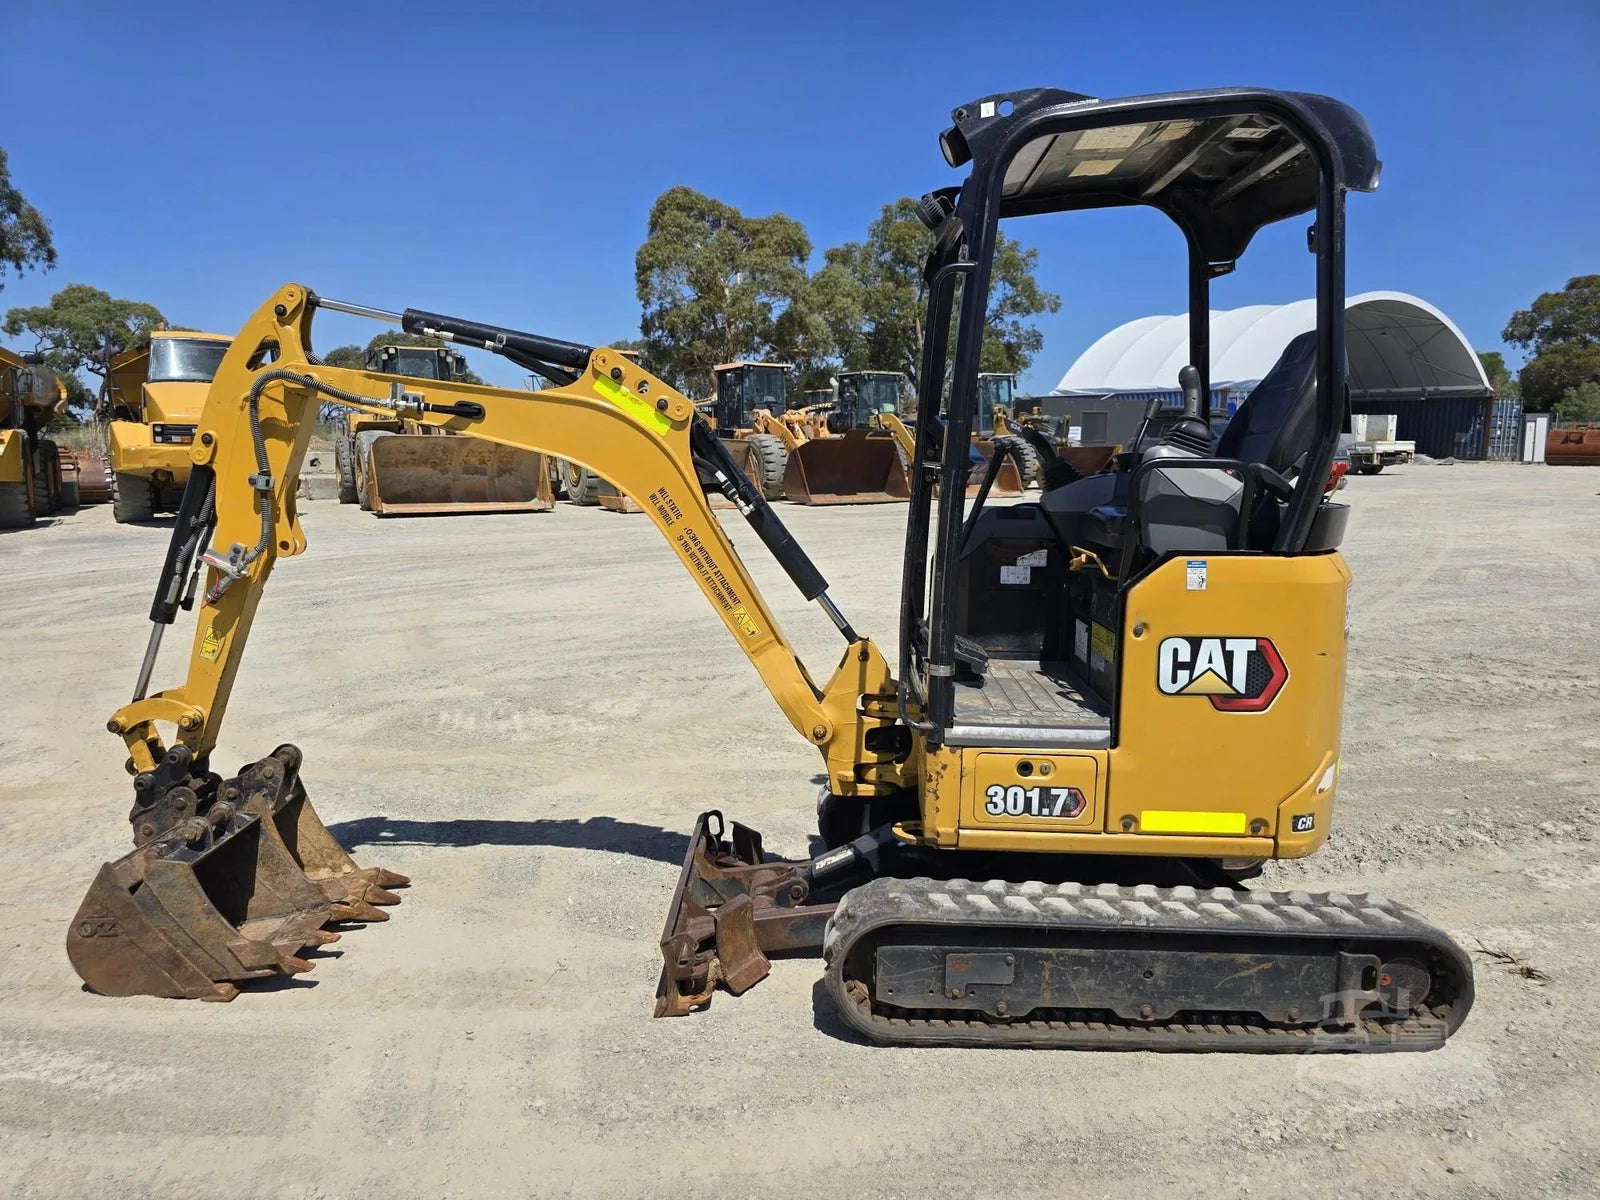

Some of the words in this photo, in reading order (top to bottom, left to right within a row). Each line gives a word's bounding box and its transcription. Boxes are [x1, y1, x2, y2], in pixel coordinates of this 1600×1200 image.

[648, 492, 661, 507] WLL
[656, 504, 676, 528] MOBILE
[704, 576, 733, 612] ATTACHMENT
[657, 486, 669, 501] WLL
[666, 498, 683, 520] STATIC
[684, 528, 702, 548] 03KG
[697, 545, 718, 570] WITHOUT
[713, 570, 742, 606] ATTACHMENT
[1159, 637, 1257, 695] CAT
[986, 785, 1069, 816] 301.7
[1297, 817, 1313, 829] CR
